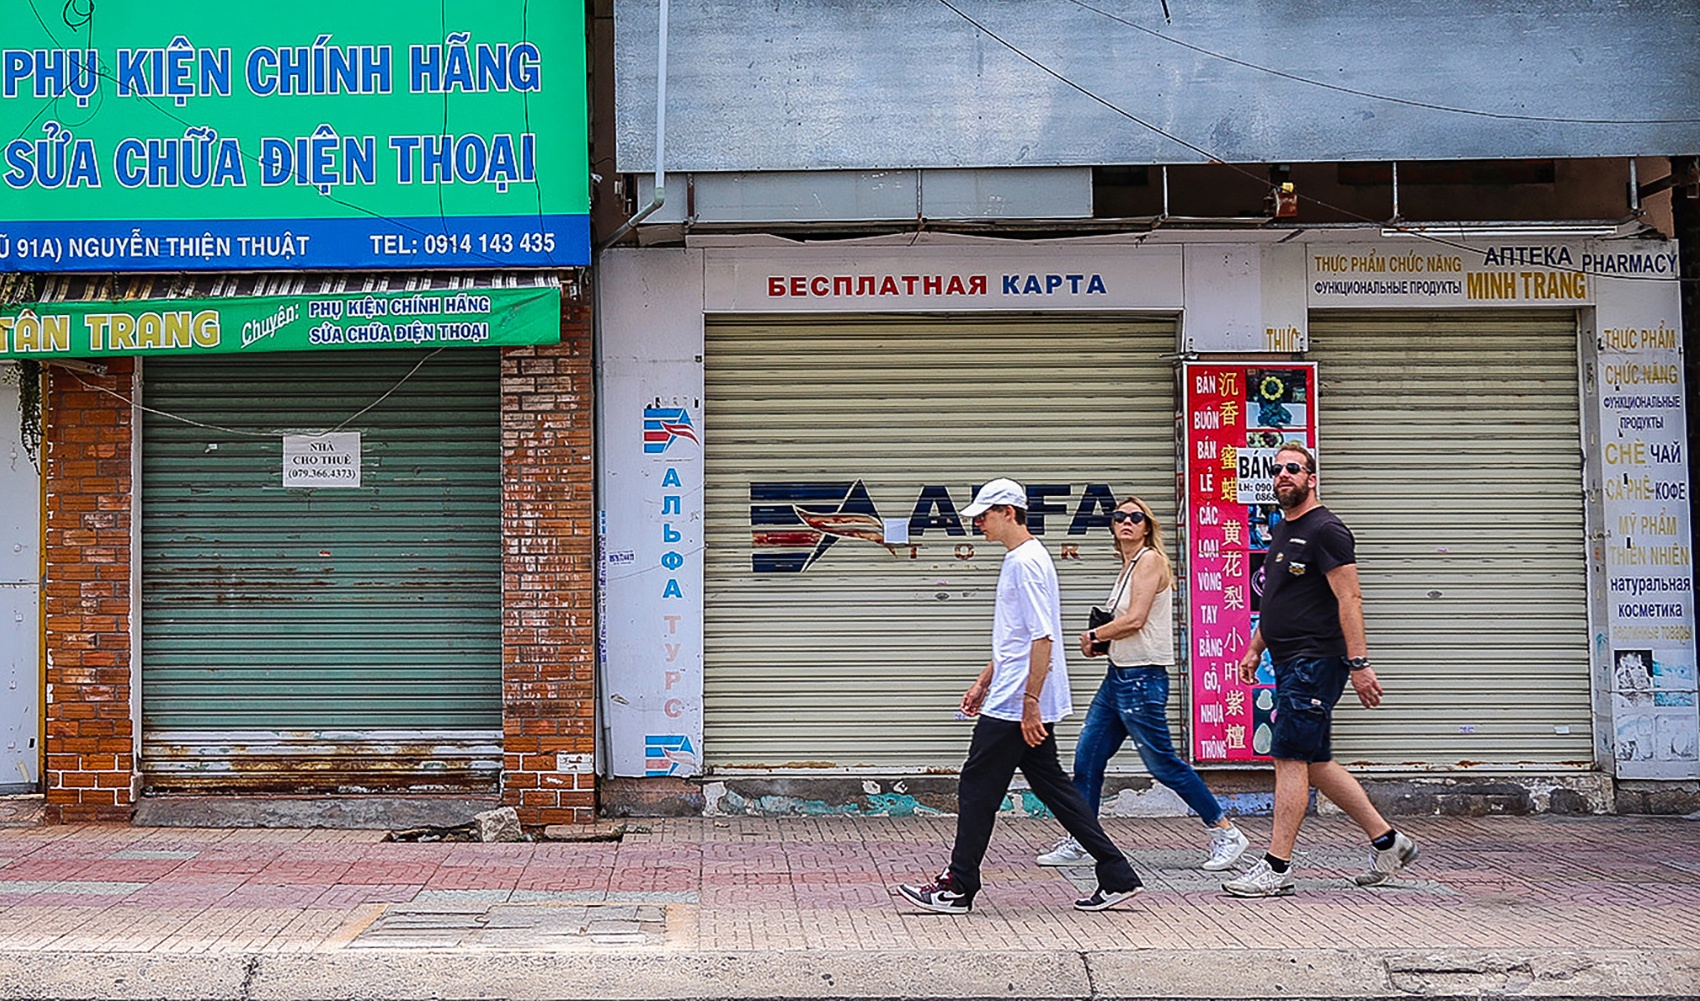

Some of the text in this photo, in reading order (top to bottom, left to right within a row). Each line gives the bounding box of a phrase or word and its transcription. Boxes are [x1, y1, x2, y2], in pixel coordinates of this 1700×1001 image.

[3, 31, 541, 107] PHỤ KIỆN CHÍNH HÃNG
[2, 120, 536, 195] SỬA CHỮA ĐIỆN THOẠI
[17, 237, 63, 263] 91A)
[68, 228, 160, 258] NGUYỄN
[165, 232, 231, 262] THIỆN
[236, 231, 310, 261] THUẬT
[369, 232, 556, 254] TEL: 0914 143 435
[1314, 249, 1462, 276] THỰC PHẨM CHỨC NĂNG
[1484, 246, 1573, 266] АПТЕКА
[1581, 253, 1678, 273] PHARMACY
[767, 274, 1107, 297] БЕСПЛАТНАЯ КАРТА
[1314, 281, 1462, 296] ФУНКЦИОНАЛЬНЫЕ ПРОДУКТЫ
[1467, 273, 1586, 299] MINH TRANG
[308, 293, 491, 319] PHỤ KIỆN CHÍNH HÃNG
[85, 310, 221, 351] TRANG
[240, 302, 300, 348] Chuyên:
[308, 322, 489, 344] SỬA CHỮA ĐIỆN THOẠI
[1196, 371, 1216, 394] BÁN
[1605, 360, 1639, 384] CHỨC
[1218, 372, 1239, 426] 沉香
[1194, 406, 1219, 429] BUÔN
[1620, 417, 1664, 430] ПРОДУКТЫ
[310, 440, 335, 452] NHÀ
[1197, 436, 1217, 460] BÁN
[1605, 438, 1681, 464] CHÈ ЧАЙ
[292, 454, 352, 465] CHO THUÊ
[1239, 450, 1273, 479] BÁN
[288, 469, 356, 479] (079.366.4373)
[1200, 466, 1214, 492] LẺ
[1238, 483, 1253, 492] LH:
[1655, 482, 1686, 499] КОФЕ
[908, 483, 1117, 536] AFA
[1200, 501, 1219, 525] CÁC
[661, 467, 683, 599] АЛЬФА
[1198, 539, 1219, 562] LOẠI
[1651, 543, 1690, 566] NHIÊN
[1221, 519, 1245, 611] 黄花梨
[1198, 567, 1222, 591] VÒNG
[1611, 576, 1690, 595] натуральная
[1201, 605, 1218, 624] TAY
[1618, 603, 1683, 618] косметика
[1199, 630, 1223, 657] BẰNG
[1204, 662, 1221, 694] GỖ,
[1223, 626, 1246, 749] 小叶紫檀
[1201, 701, 1224, 727] NHỰA
[1201, 735, 1227, 759] THÔNG
